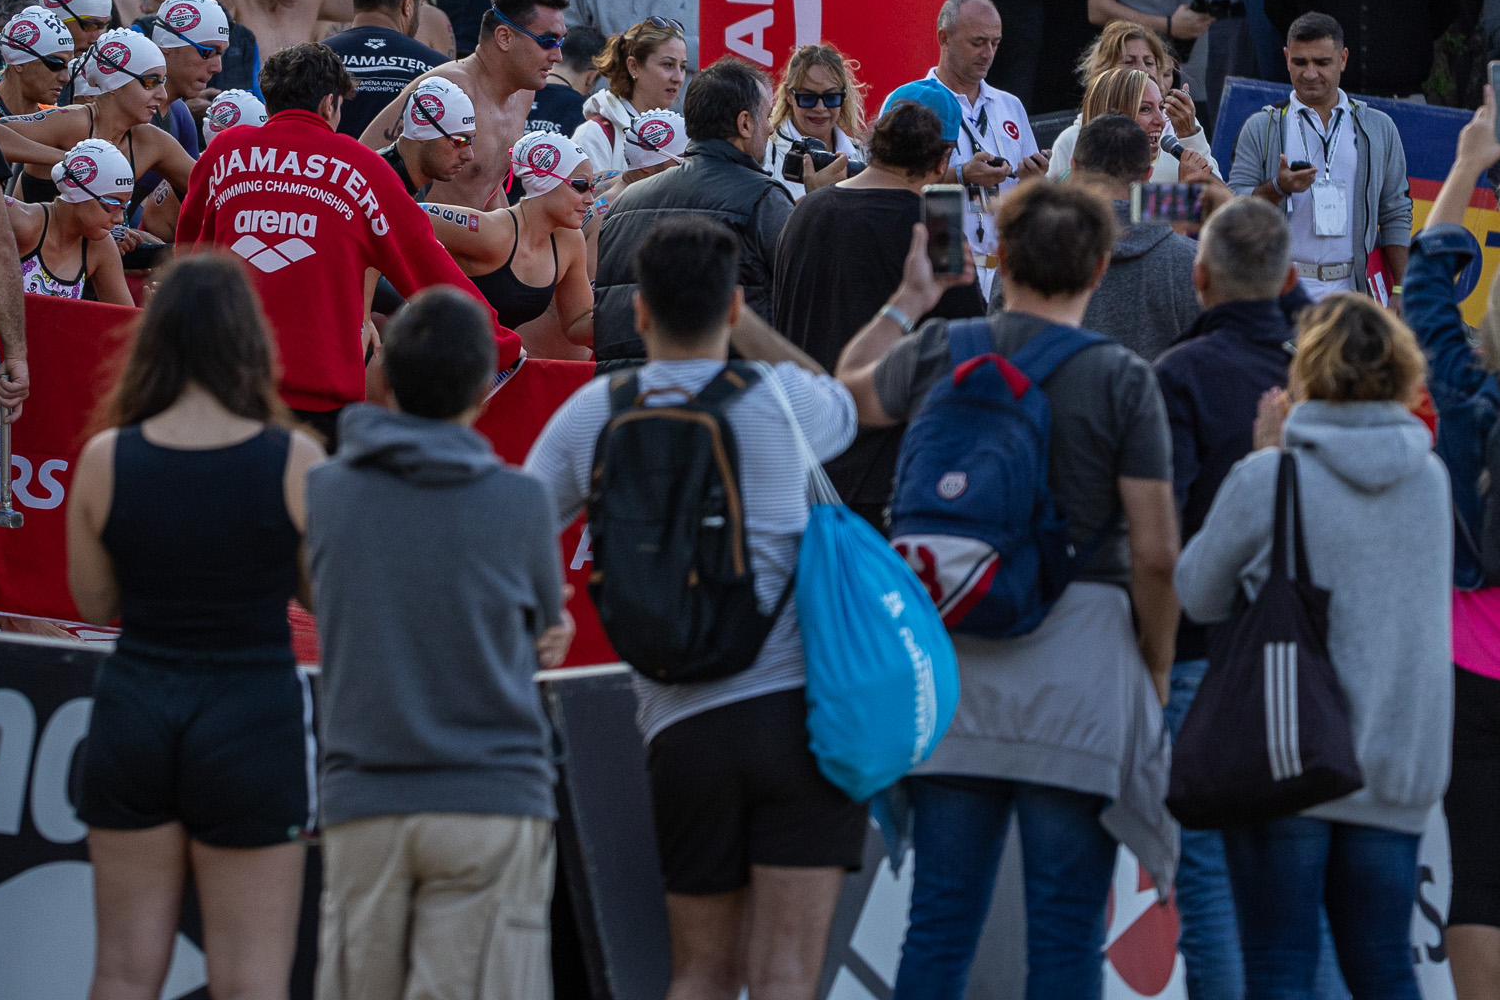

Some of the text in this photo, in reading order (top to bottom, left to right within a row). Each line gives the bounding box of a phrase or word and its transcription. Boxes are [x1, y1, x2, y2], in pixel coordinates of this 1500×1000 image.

[218, 26, 229, 35] are
[58, 37, 73, 46] are
[462, 116, 475, 125] are
[214, 180, 263, 211] SWIMMING
[265, 180, 355, 221] CHAMPIONSHIPS
[234, 209, 318, 238] arena
